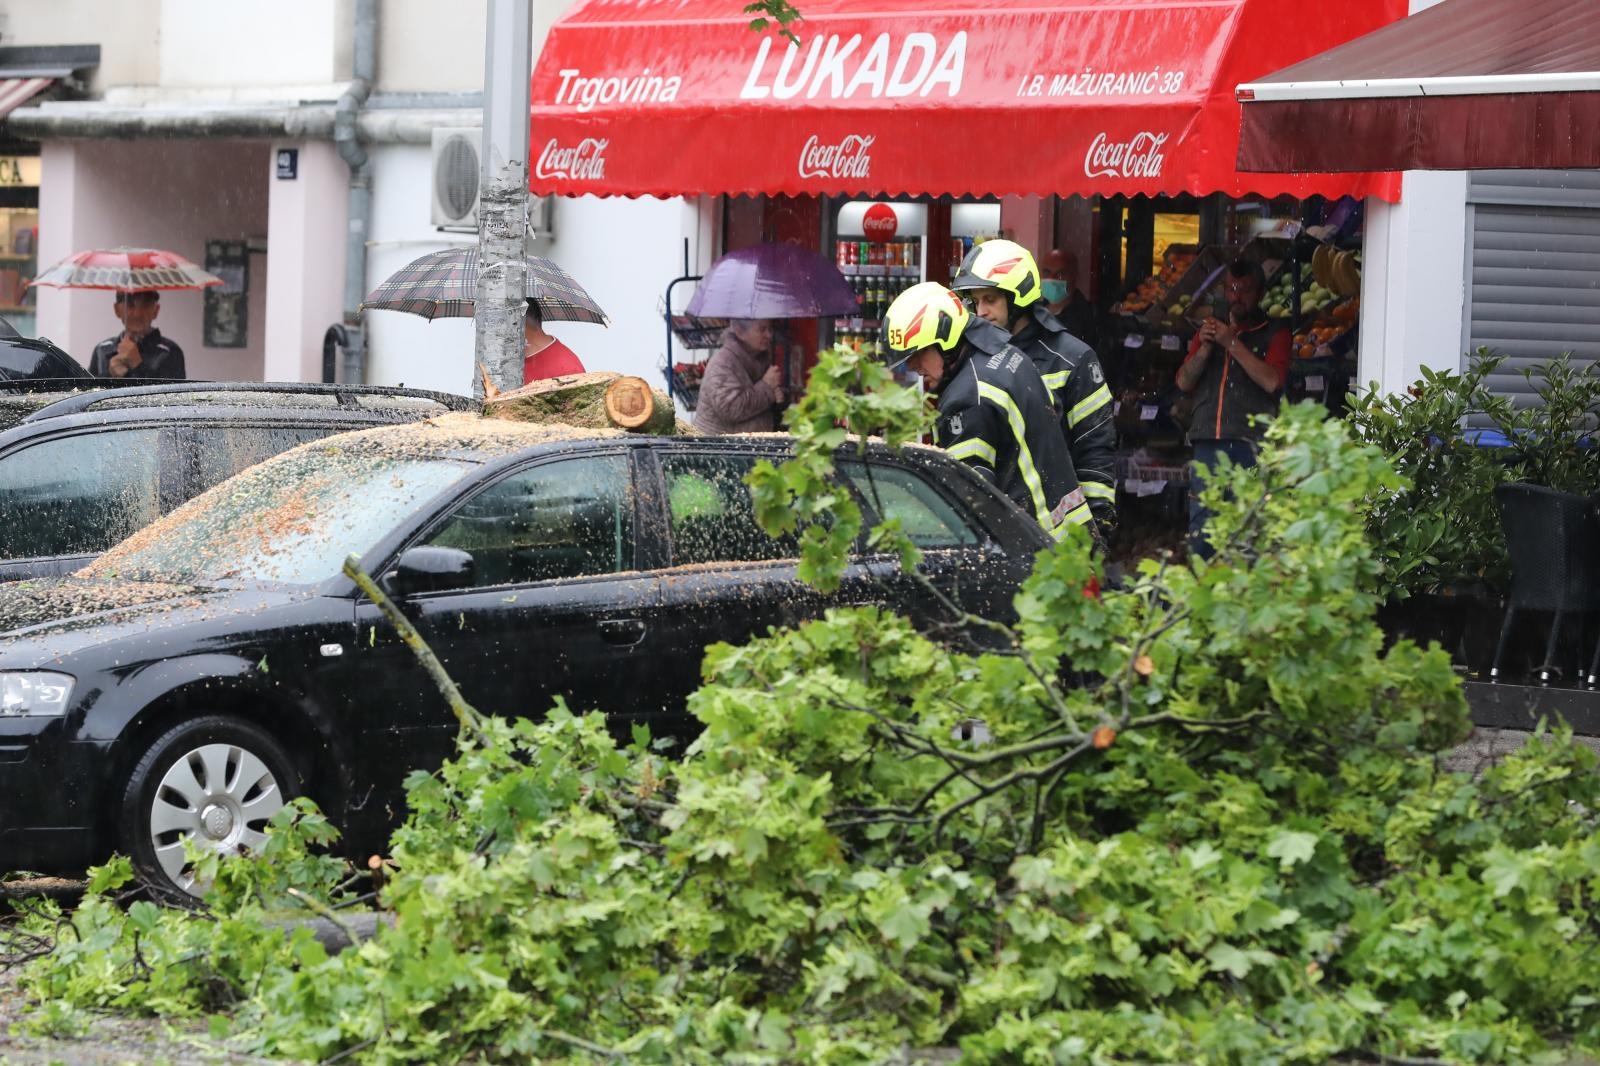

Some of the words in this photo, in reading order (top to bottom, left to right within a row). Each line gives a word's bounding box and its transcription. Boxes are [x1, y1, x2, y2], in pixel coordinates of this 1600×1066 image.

[739, 30, 967, 99] LUKADA
[1016, 74, 1044, 97] I.B.
[1047, 65, 1161, 97] MAŽURANIĆ
[1159, 70, 1185, 95] 38
[554, 67, 682, 112] Trgovina
[536, 137, 610, 180] Coca-Cola
[798, 133, 877, 178] Coca-Cola
[1084, 131, 1170, 178] Coca-Cola
[890, 329, 902, 345] 35
